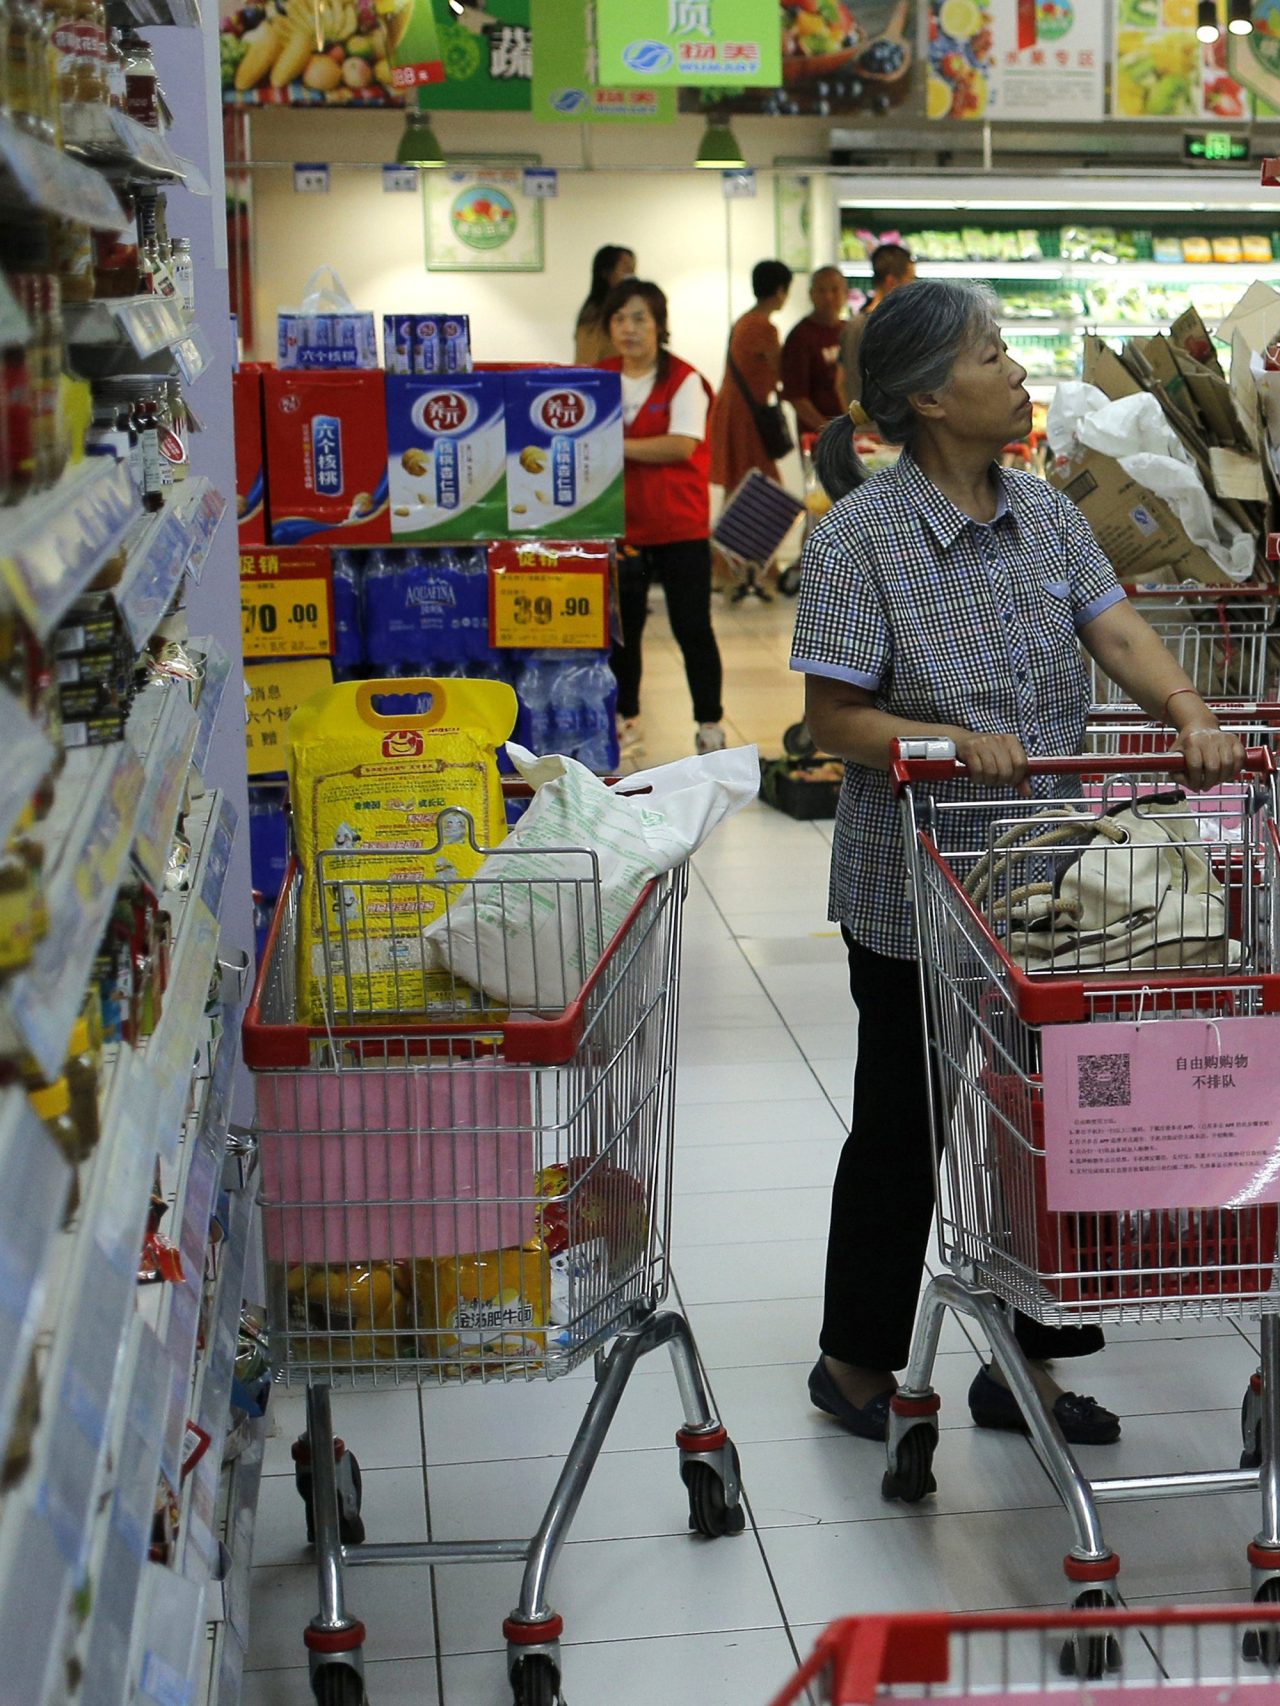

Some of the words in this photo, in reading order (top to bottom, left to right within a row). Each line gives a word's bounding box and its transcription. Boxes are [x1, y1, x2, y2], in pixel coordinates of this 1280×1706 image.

[679, 42, 760, 60] 物美
[316, 423, 338, 486] 六个核桃
[405, 585, 456, 607] AQUAFINA
[248, 705, 298, 724] 六个核
[1175, 1054, 1249, 1071] 自由购购物
[1192, 1074, 1236, 1089] 不排队
[454, 1305, 533, 1329] 金汤肥牛面
